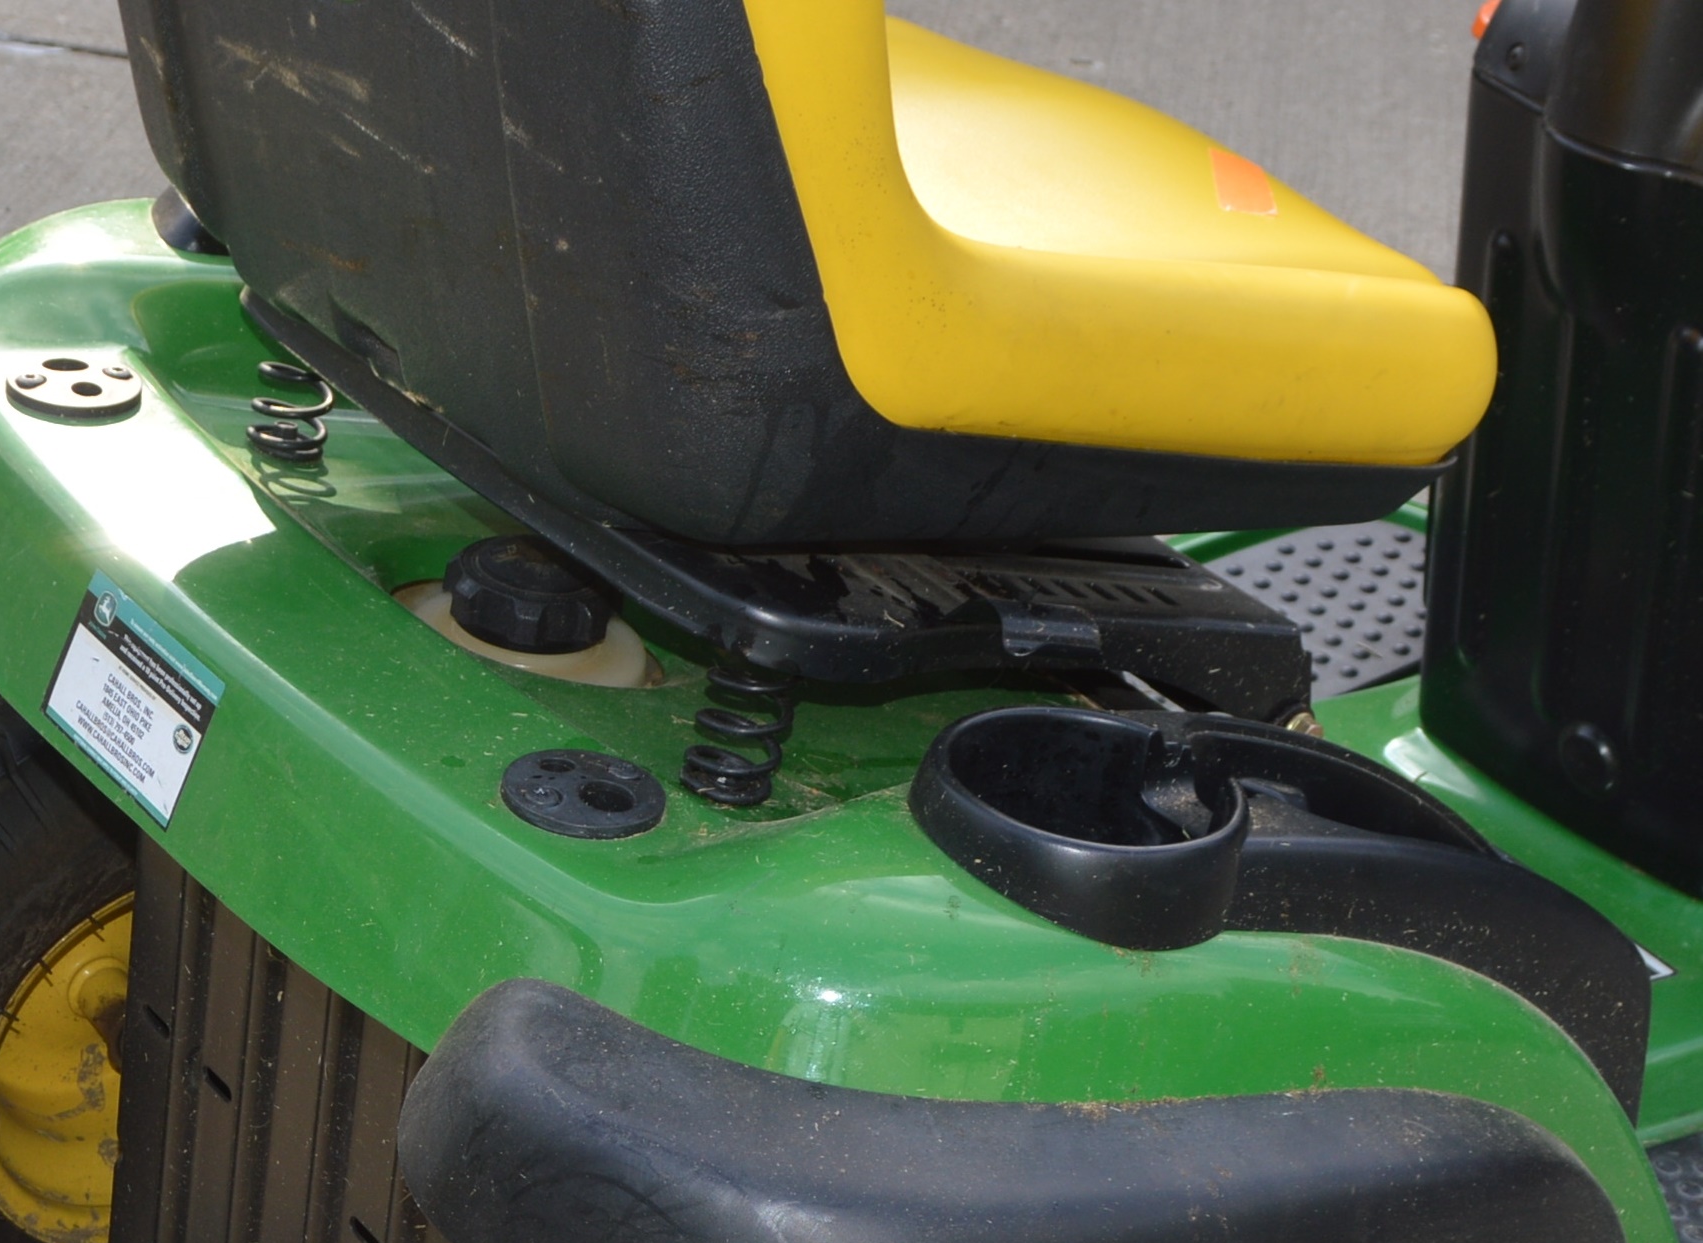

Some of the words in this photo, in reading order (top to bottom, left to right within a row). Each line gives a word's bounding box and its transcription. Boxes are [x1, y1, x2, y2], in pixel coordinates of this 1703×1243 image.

[107, 672, 127, 696] CAHALL
[112, 691, 127, 709] EAST
[125, 703, 140, 722] OHIO
[138, 715, 152, 732] PIKE
[121, 714, 130, 727] OH
[77, 715, 145, 783] WWW.CAHALLBROSINC.COM
